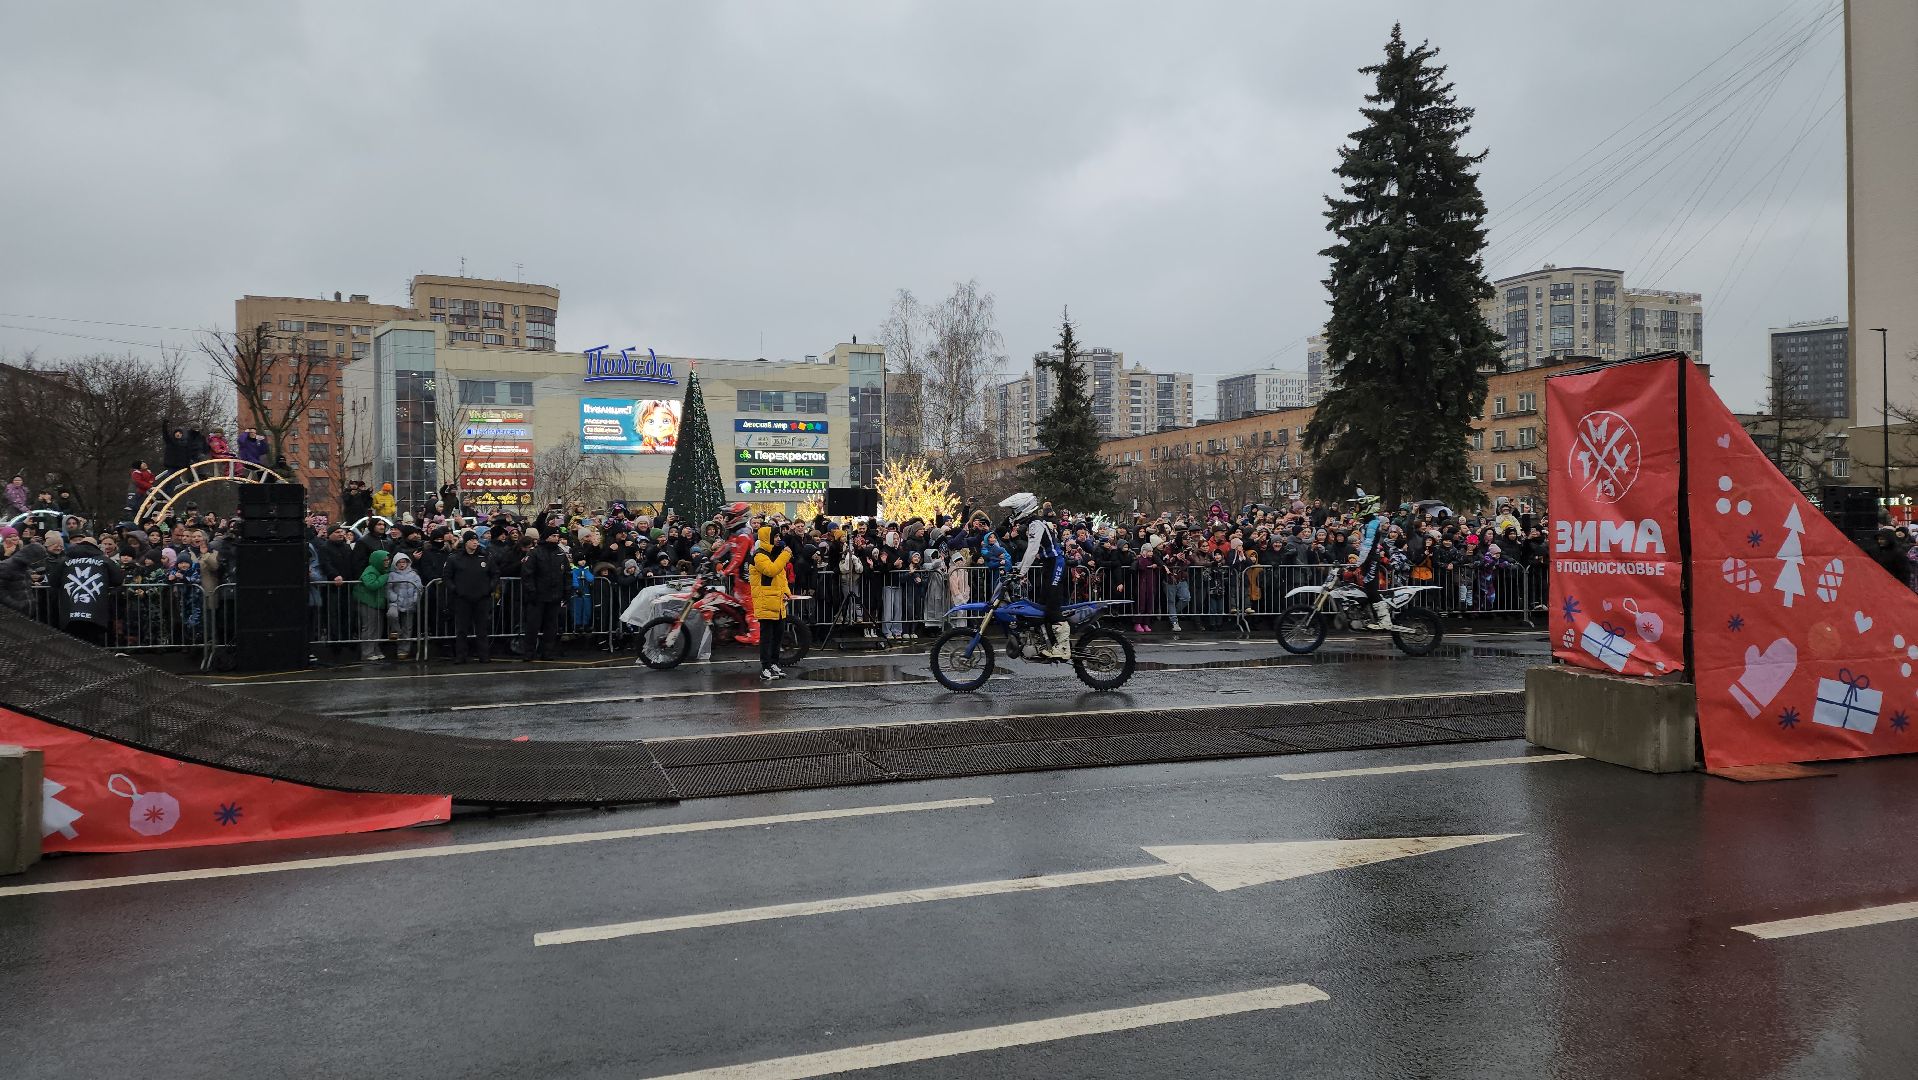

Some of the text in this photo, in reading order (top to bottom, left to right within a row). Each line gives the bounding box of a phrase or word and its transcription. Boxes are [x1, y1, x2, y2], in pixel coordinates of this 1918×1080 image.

[584, 344, 673, 378] Победа
[464, 444, 493, 453] DNS
[750, 467, 814, 476] СУПЕРМАРКЕТ
[1555, 519, 1666, 553] ЗИМА
[1563, 561, 1665, 576] ПОДМОСКОВЬЕ
